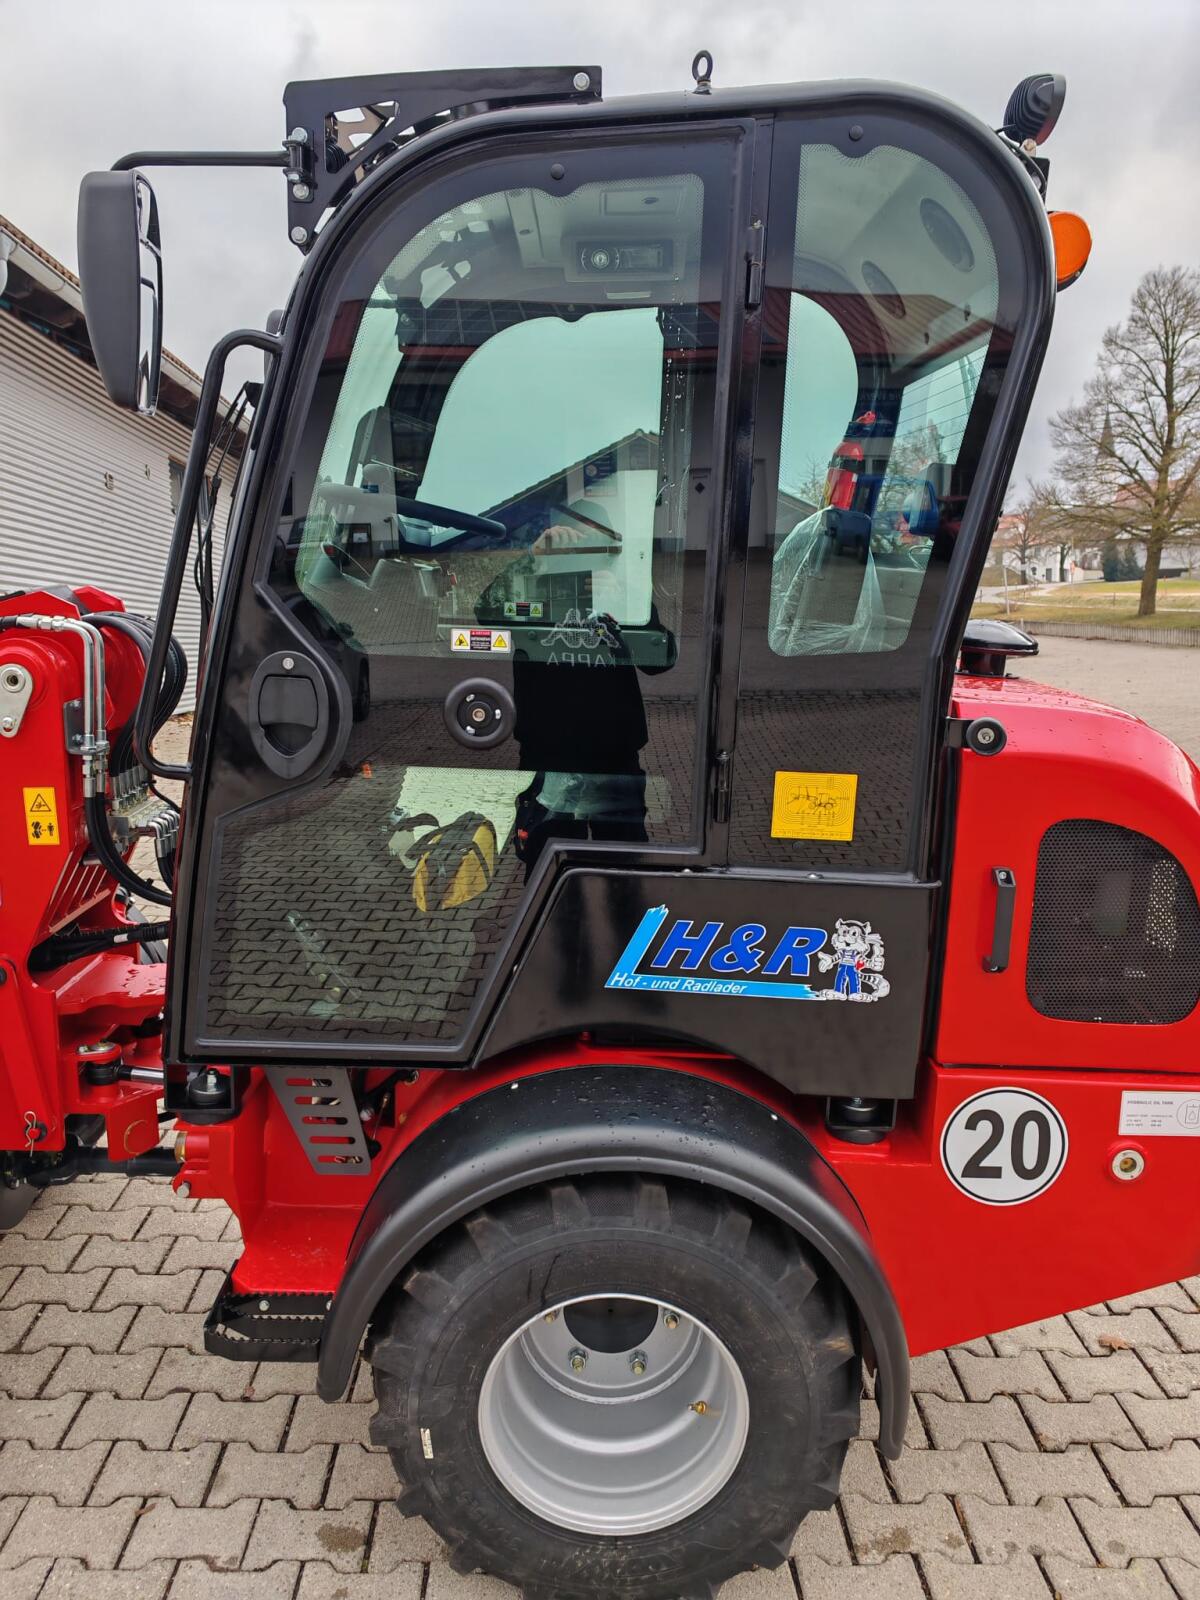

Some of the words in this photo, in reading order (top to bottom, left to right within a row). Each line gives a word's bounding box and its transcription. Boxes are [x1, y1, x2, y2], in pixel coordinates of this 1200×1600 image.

[650, 919, 827, 977] H&R
[651, 978, 680, 990] und
[681, 979, 747, 994] Radlader
[961, 1109, 1051, 1180] 20
